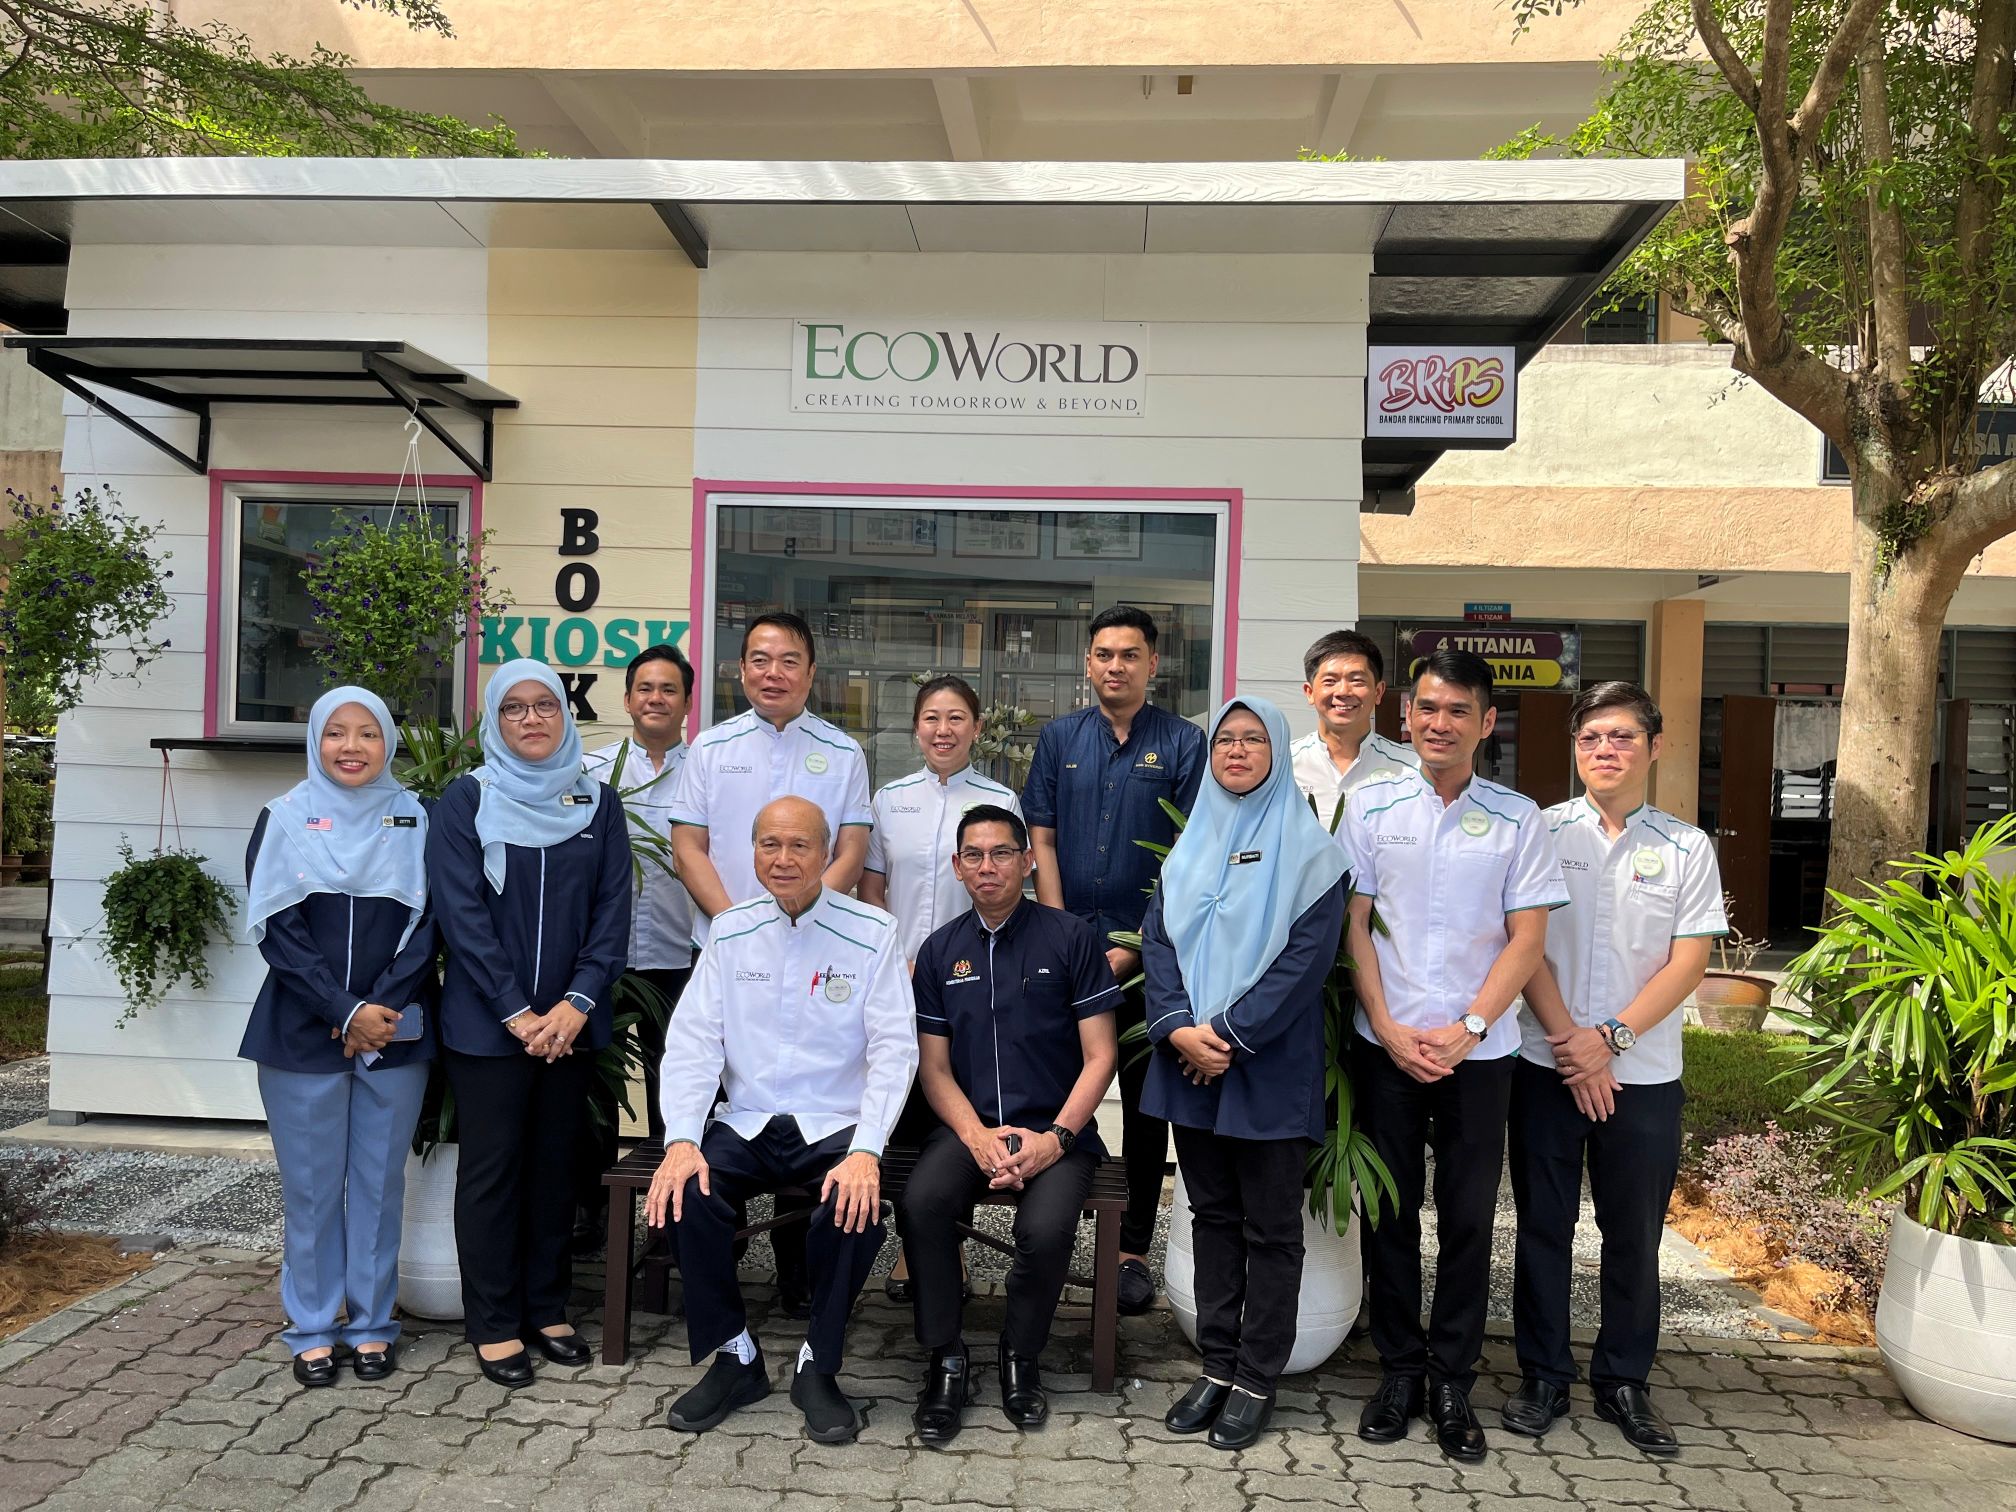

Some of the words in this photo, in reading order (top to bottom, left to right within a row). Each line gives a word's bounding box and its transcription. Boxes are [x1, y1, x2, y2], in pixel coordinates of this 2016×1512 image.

[805, 393, 901, 408] CREATING
[910, 395, 1026, 409] TOMORROW
[1036, 398, 1048, 410] &
[1059, 397, 1138, 411] BEYOND
[1379, 415, 1407, 424] BANDAR
[1409, 415, 1441, 424] RINCHING
[1444, 415, 1474, 425] PRIMARY
[1476, 416, 1504, 425] SCHOOL
[1436, 637, 1448, 650] 4
[1454, 637, 1536, 654] TITANIA
